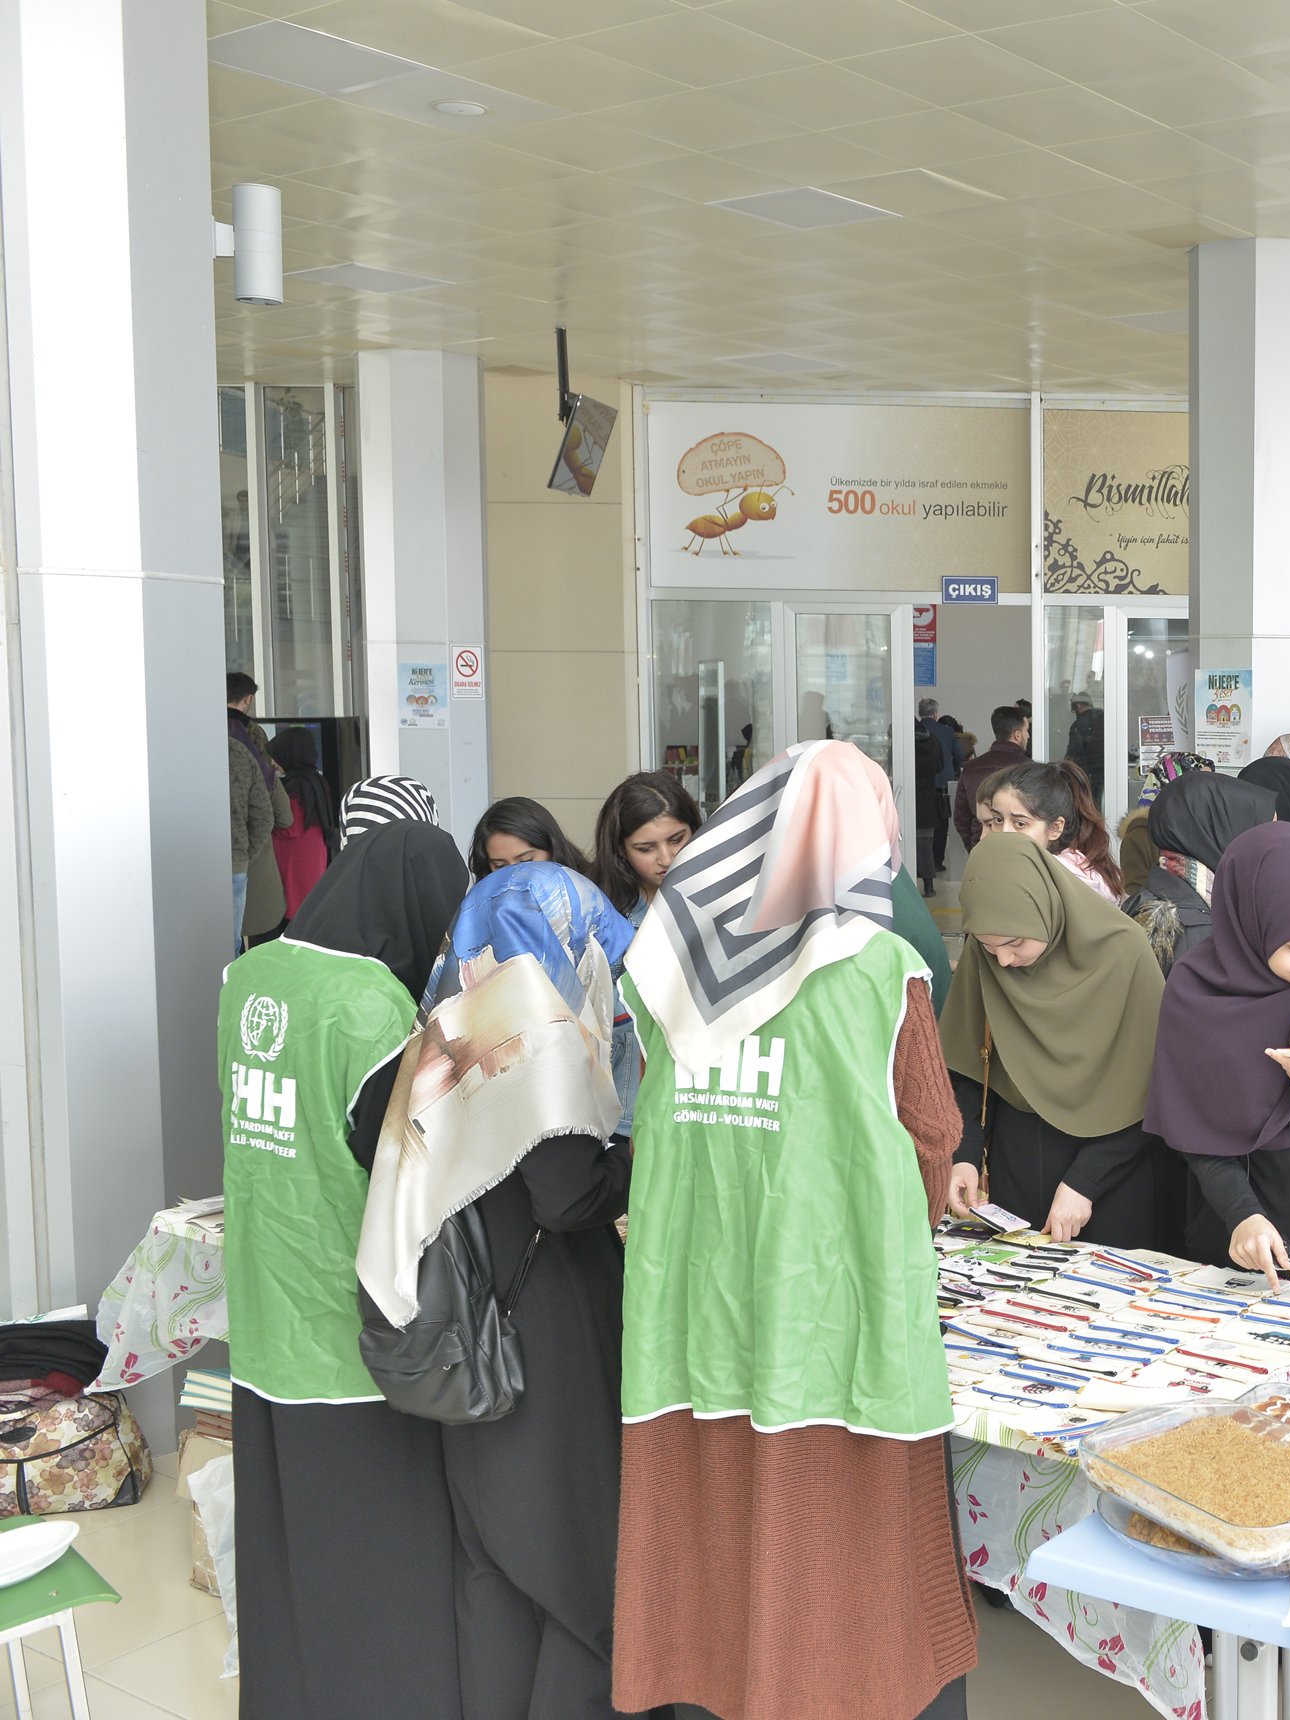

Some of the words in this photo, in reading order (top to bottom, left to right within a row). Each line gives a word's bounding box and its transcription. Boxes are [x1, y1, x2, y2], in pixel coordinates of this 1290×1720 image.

[710, 439, 743, 456] ÇÖPE
[701, 454, 752, 472] ATMAYIN
[696, 474, 728, 488] OKUL
[730, 468, 765, 483] YAPIN
[830, 476, 878, 487] Ülkemizde
[880, 478, 892, 488] bir
[895, 479, 916, 490] yılda
[918, 479, 939, 489] israf
[941, 479, 968, 489] edilen
[970, 480, 1008, 490] ekmekle
[827, 489, 876, 515] 500
[879, 499, 916, 516] okul
[922, 501, 1008, 520] yapılabilir
[1140, 535, 1155, 546] için
[1156, 533, 1180, 549] fakat
[948, 584, 992, 599] ÇIKIŞ
[240, 1118, 273, 1135] YARDIM
[272, 1127, 296, 1142] AKFI
